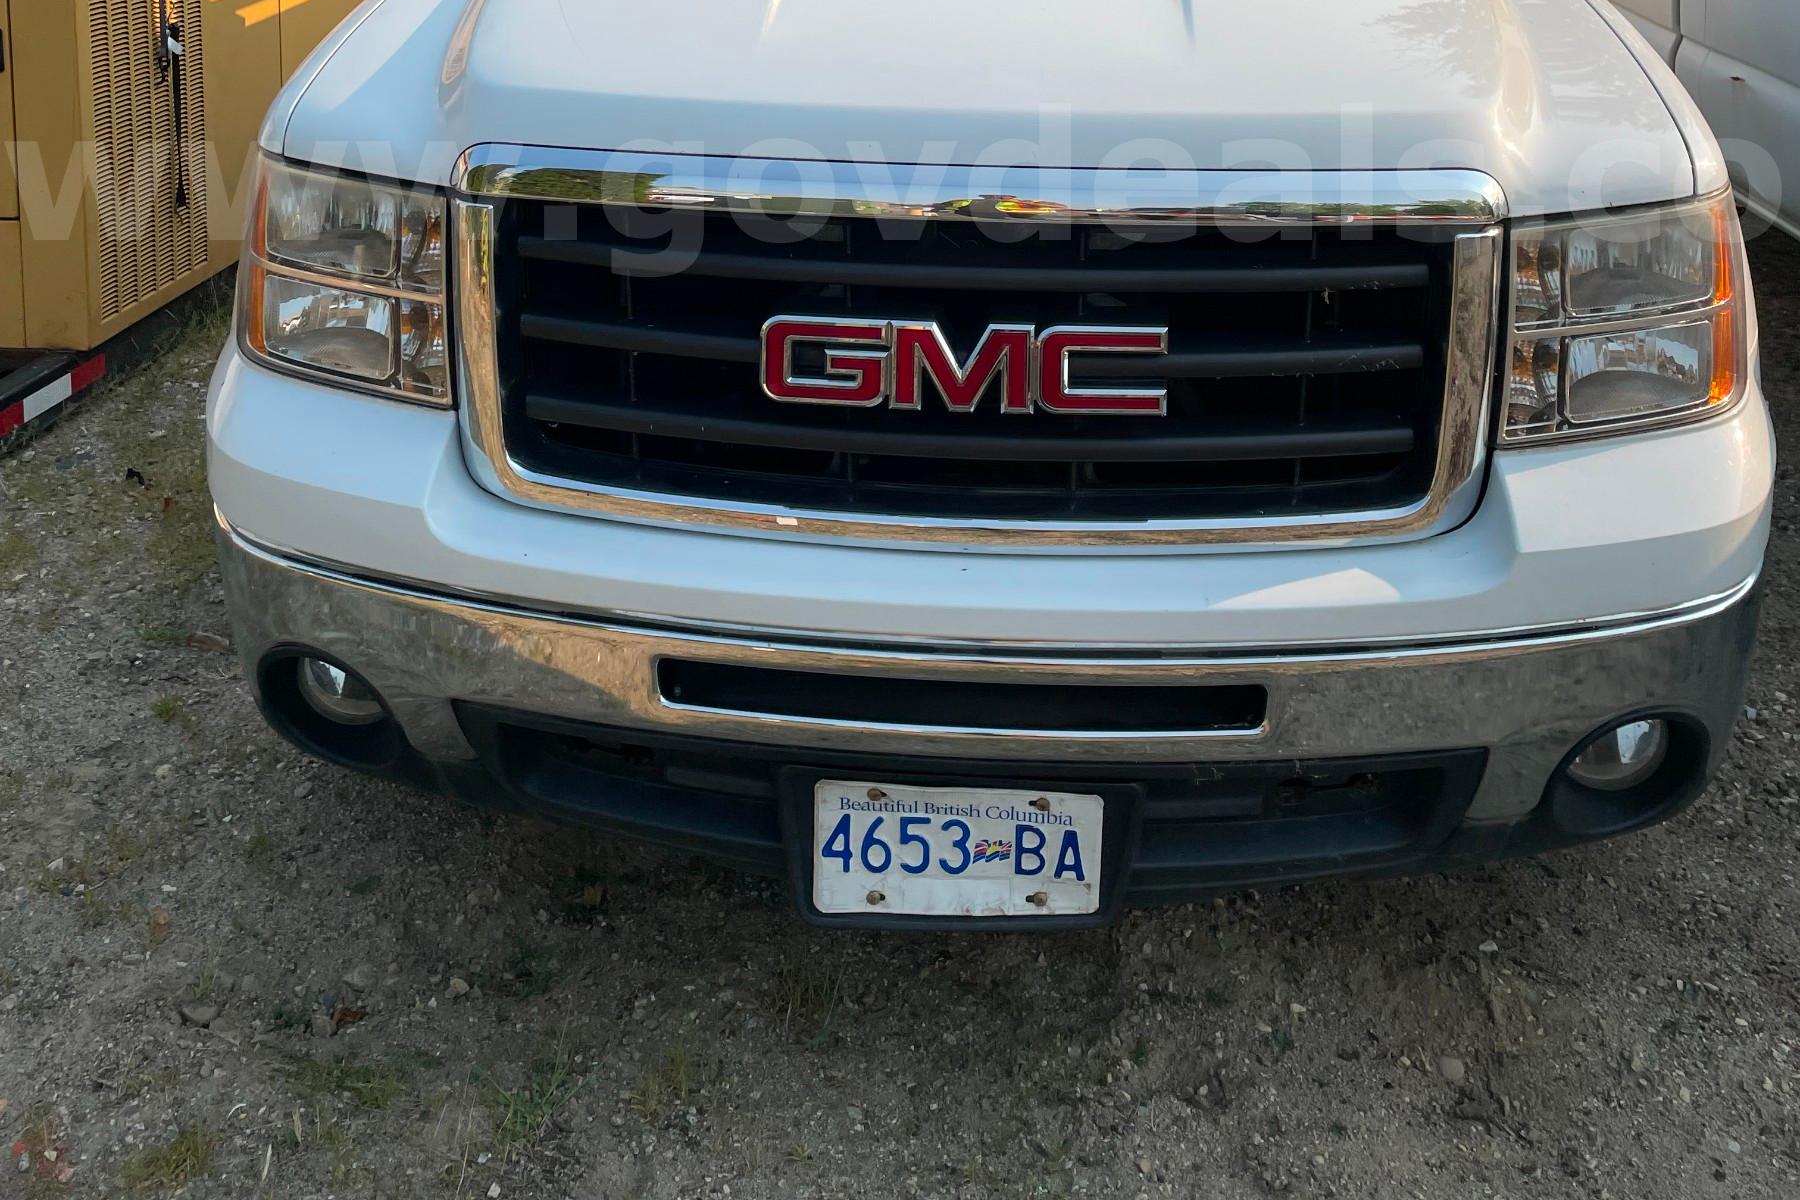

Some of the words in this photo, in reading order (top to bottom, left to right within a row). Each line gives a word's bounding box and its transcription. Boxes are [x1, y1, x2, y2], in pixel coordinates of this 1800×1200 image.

[759, 314, 1169, 416] GMC
[839, 797, 919, 814] Beautiful
[924, 802, 981, 819] British
[985, 806, 1073, 826] Columbia
[821, 814, 971, 874] 4653
[1014, 824, 1085, 881] BA
